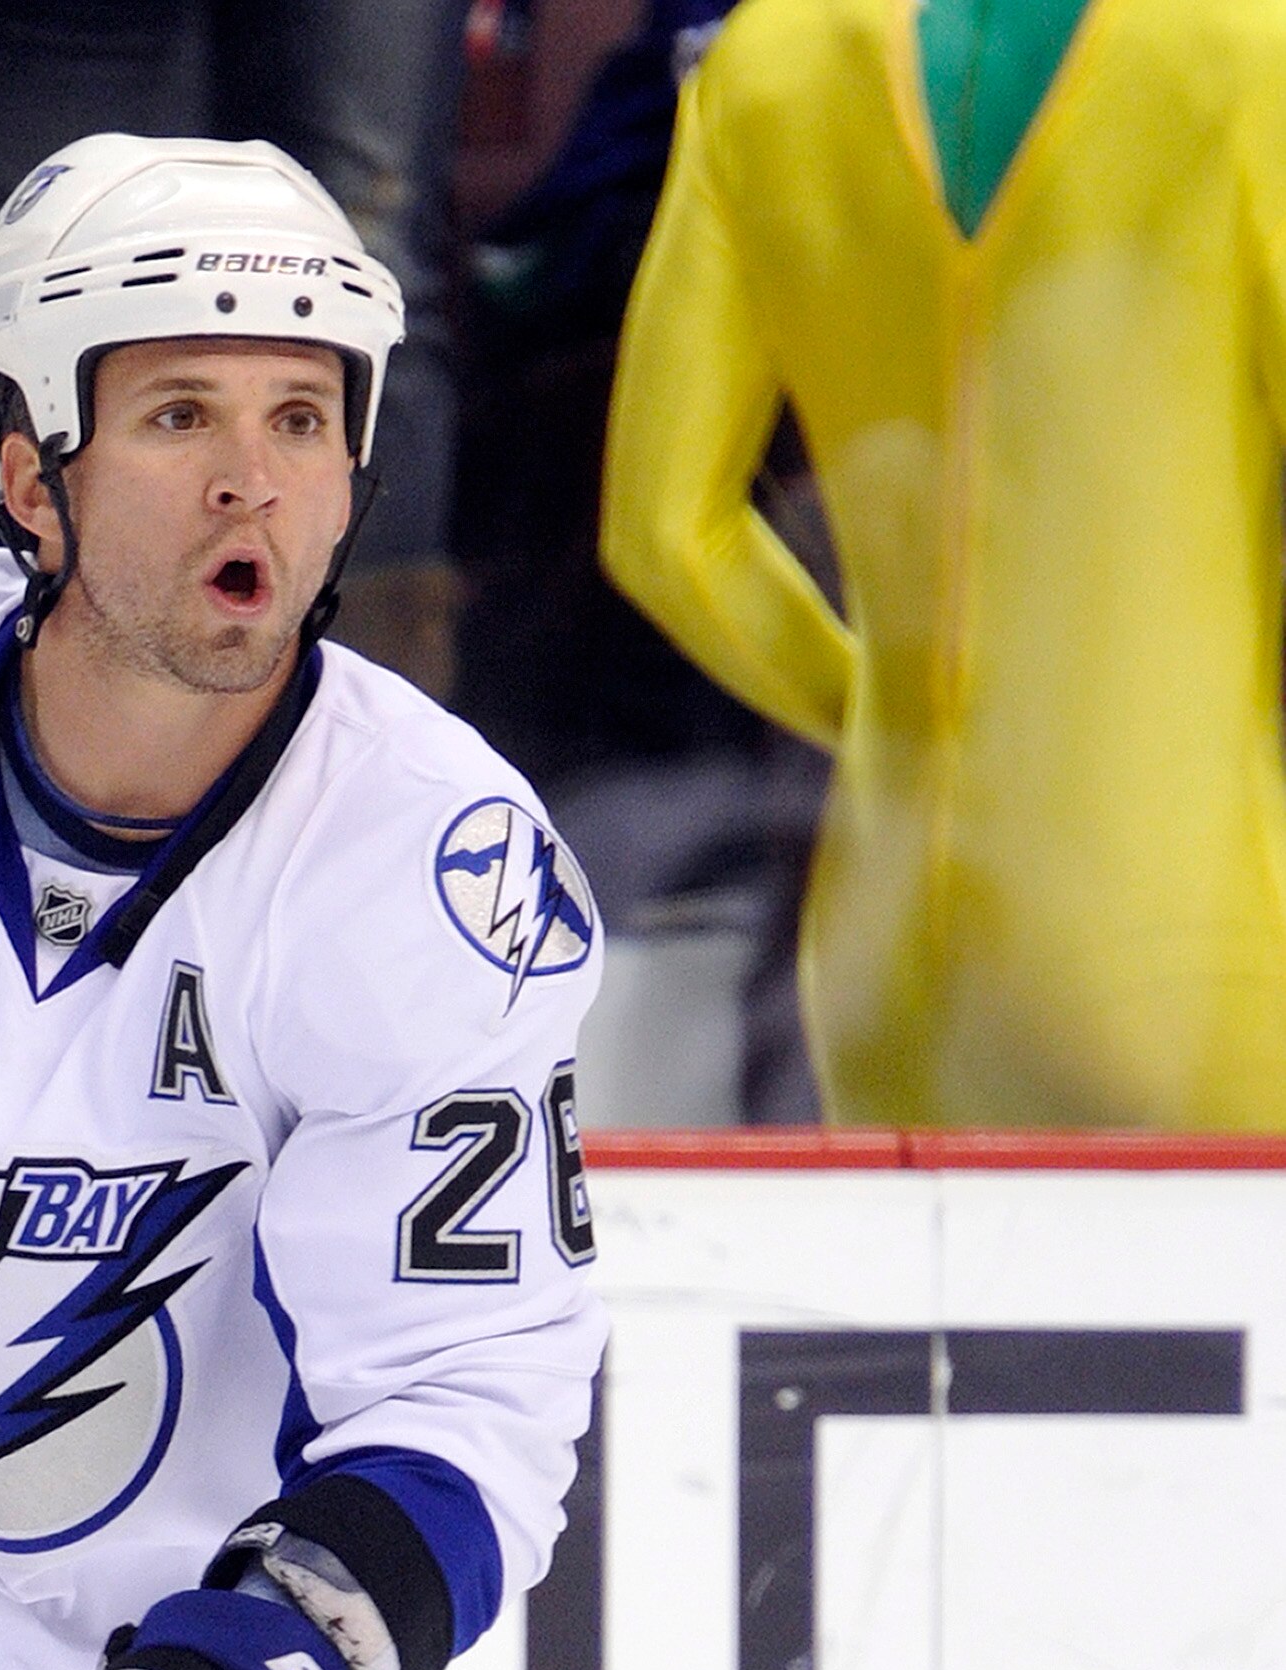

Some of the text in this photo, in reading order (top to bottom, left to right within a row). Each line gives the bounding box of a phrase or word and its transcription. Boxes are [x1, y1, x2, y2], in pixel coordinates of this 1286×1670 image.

[195, 252, 327, 276] BAUER
[148, 959, 239, 1106] A
[10, 1168, 168, 1251] BAY
